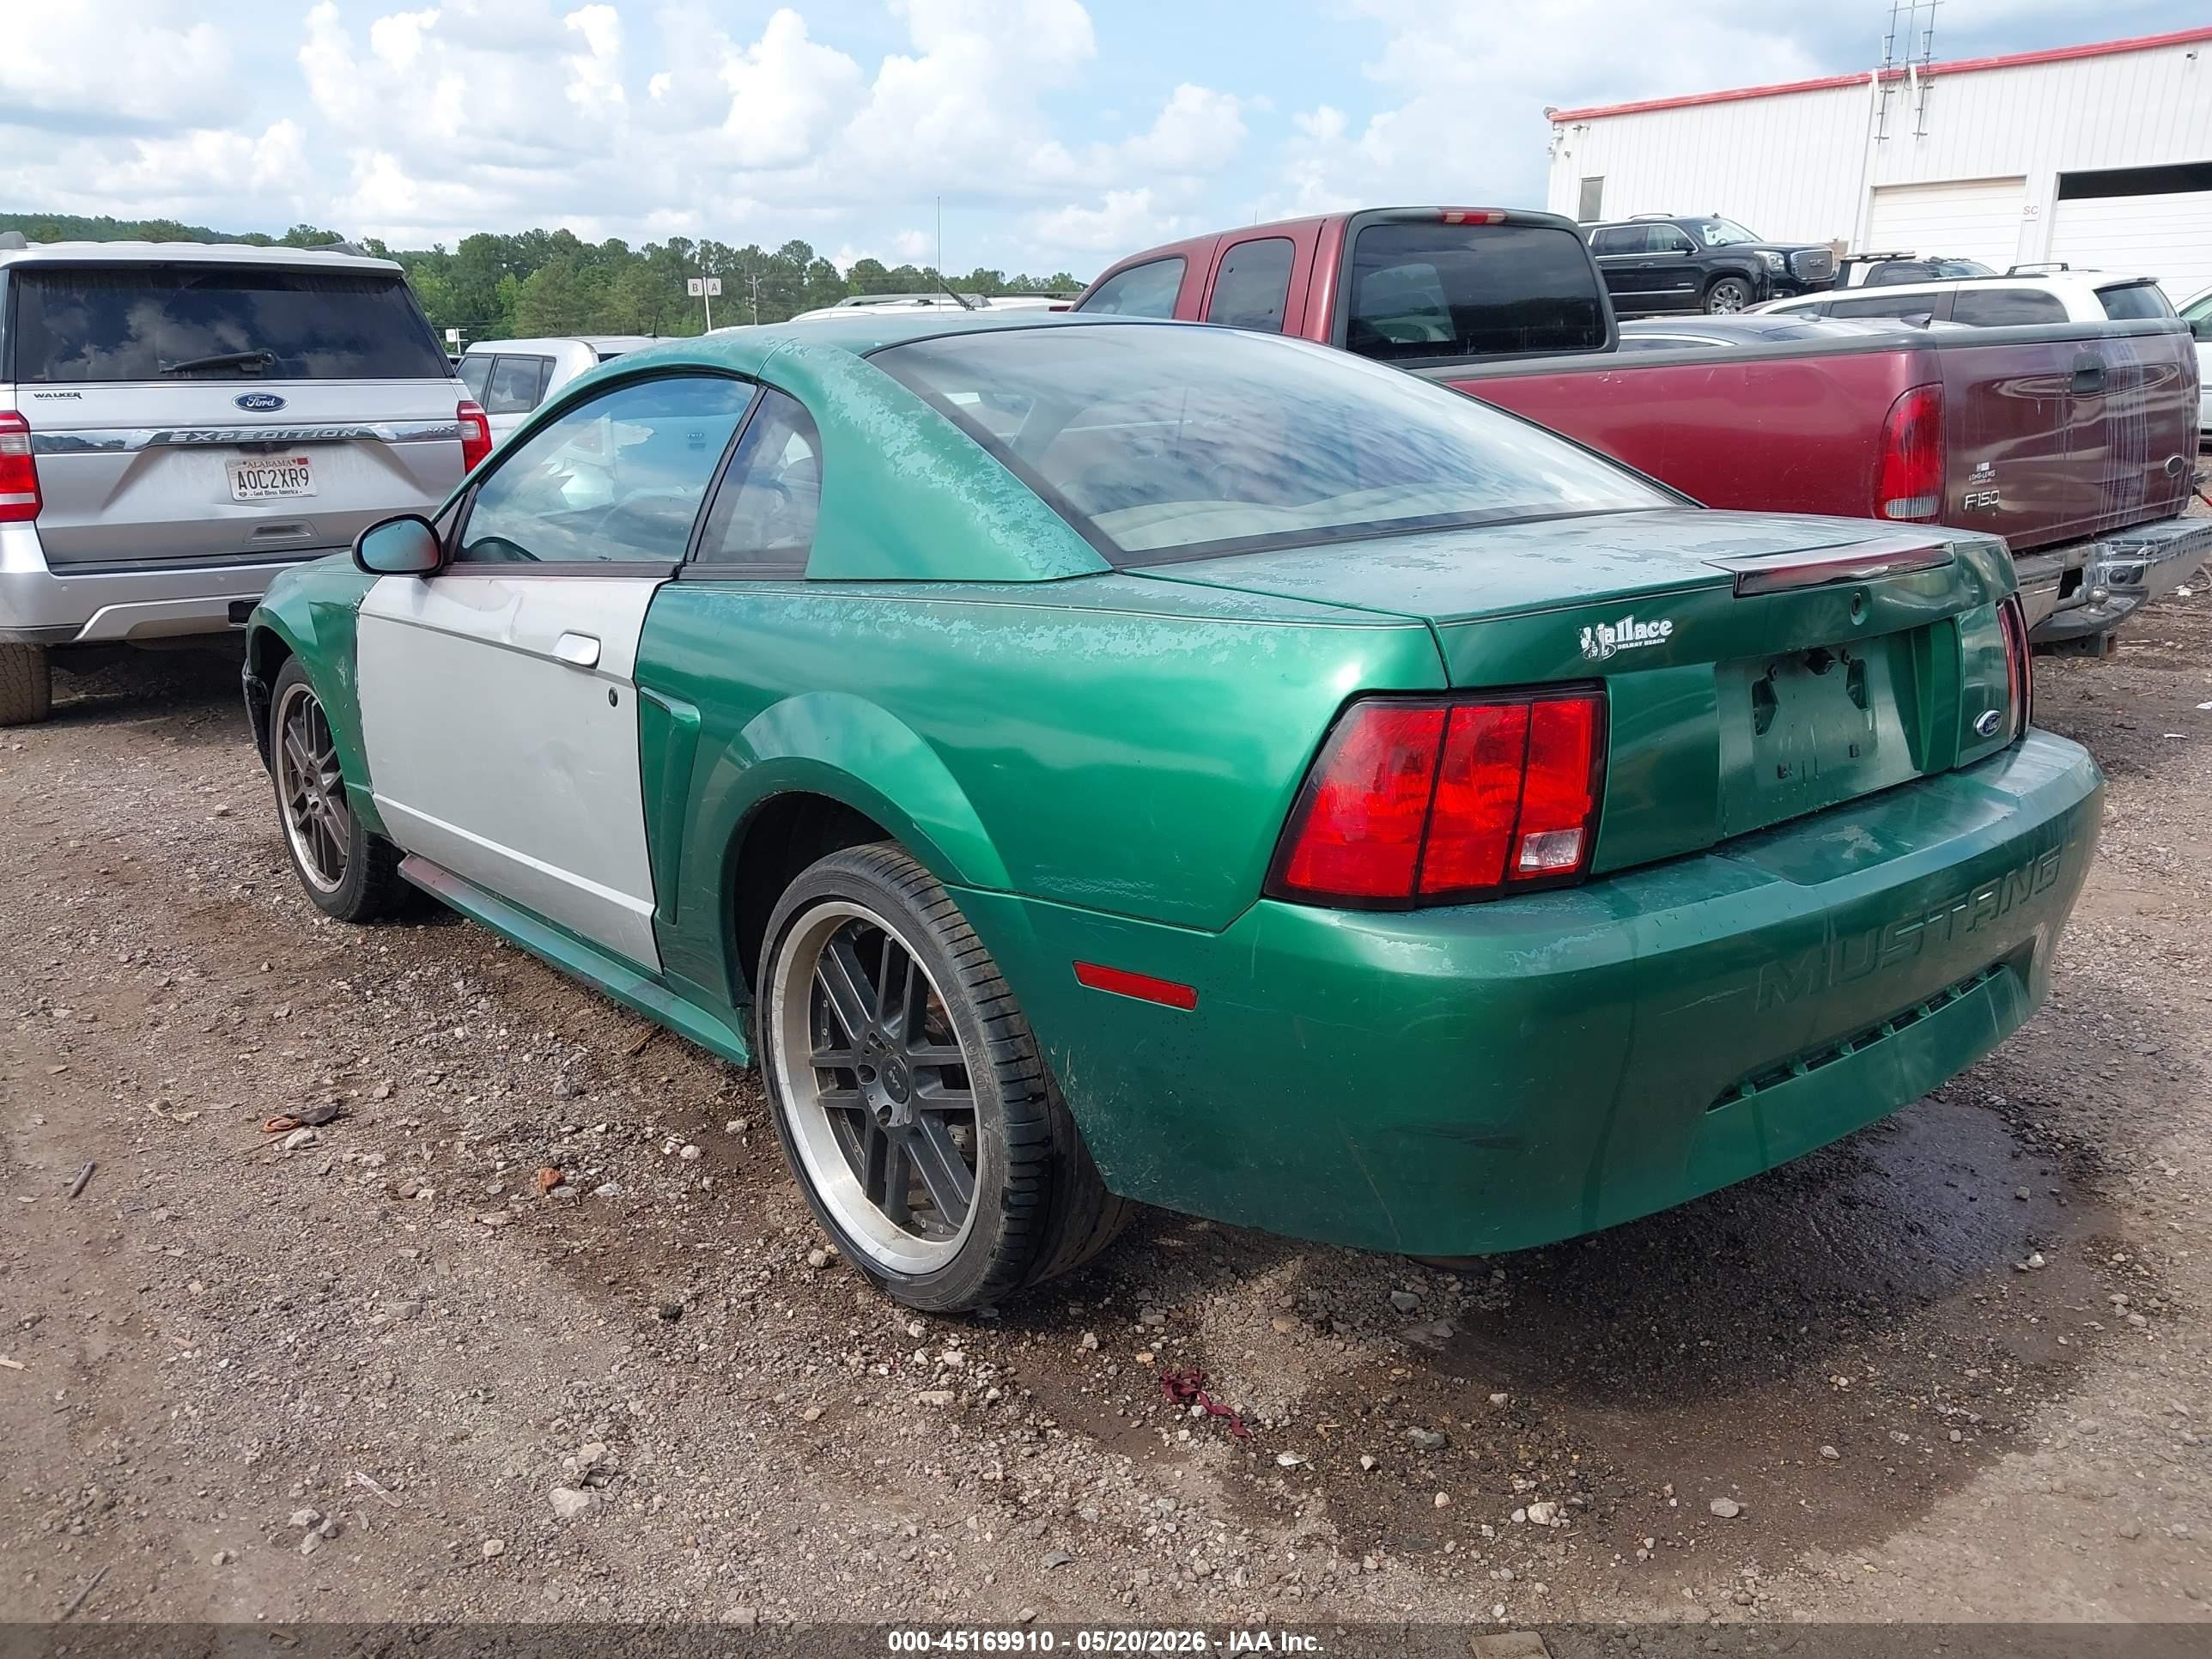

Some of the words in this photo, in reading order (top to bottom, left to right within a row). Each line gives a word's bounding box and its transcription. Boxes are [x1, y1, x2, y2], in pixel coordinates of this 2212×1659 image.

[2022, 205, 2039, 216] SC
[692, 283, 699, 293] B
[711, 283, 718, 292] A
[33, 392, 83, 400] WALKER
[246, 395, 276, 407] Ford
[168, 428, 359, 442] EXPEDITION
[247, 459, 293, 468] ALABAMA
[1756, 844, 2062, 1014] MUSTANG
